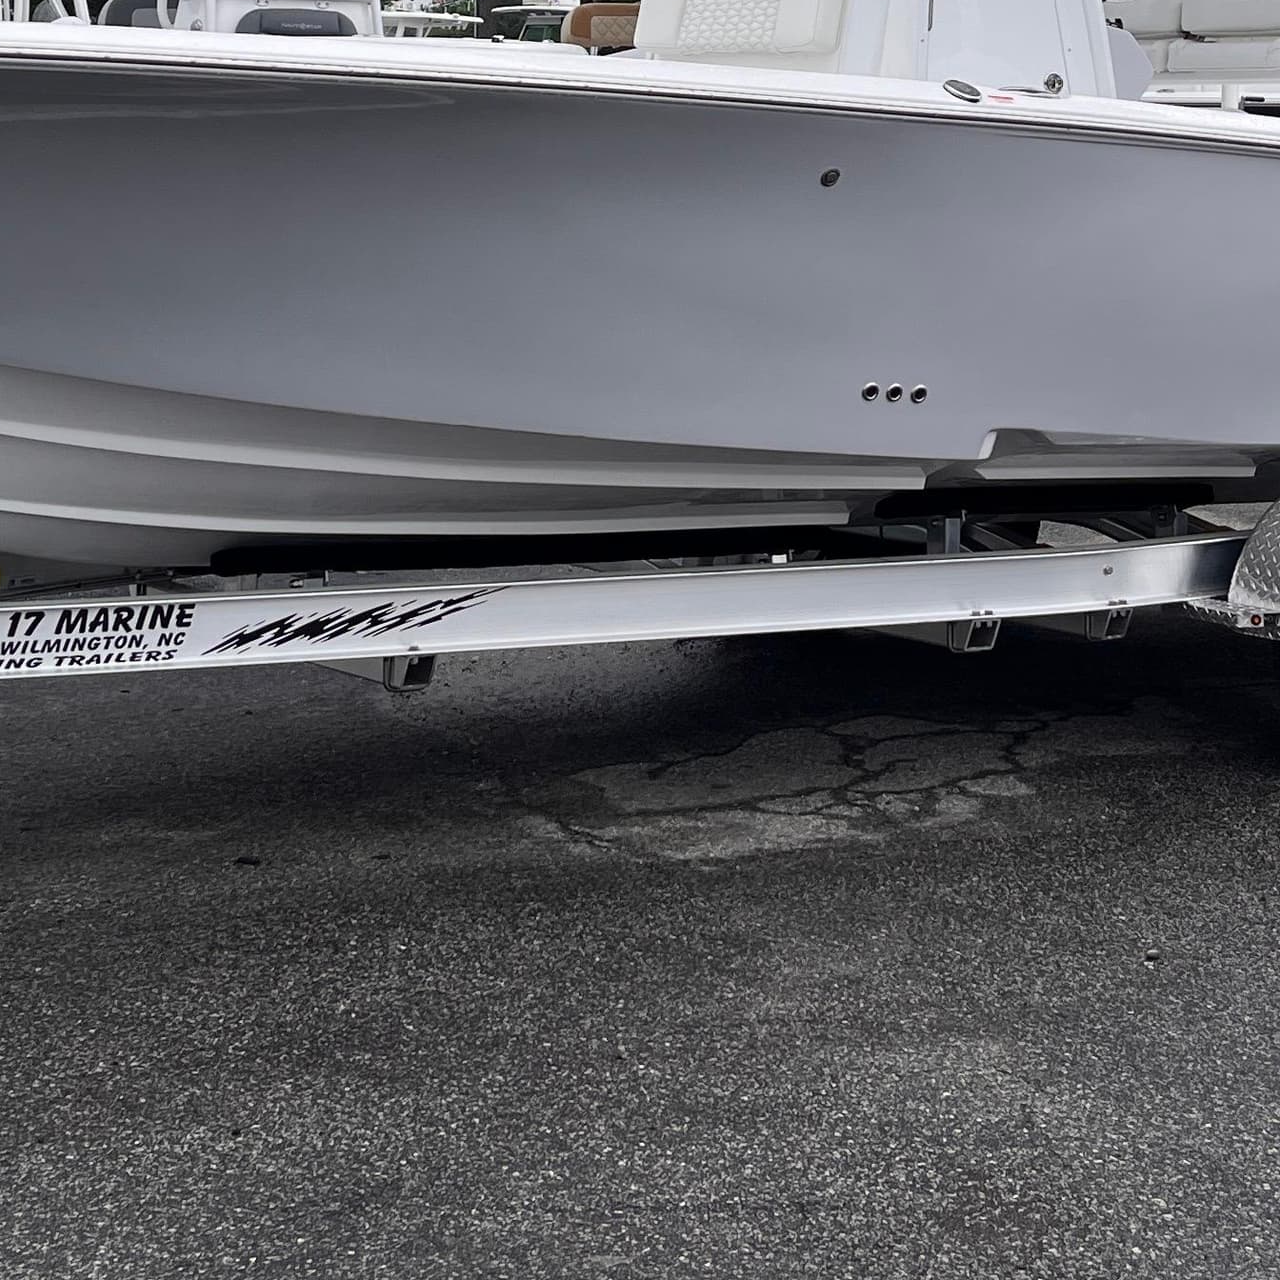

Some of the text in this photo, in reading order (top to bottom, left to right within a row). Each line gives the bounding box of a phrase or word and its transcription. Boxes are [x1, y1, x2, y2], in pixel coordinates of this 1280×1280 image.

[7, 611, 46, 637] 17
[54, 603, 196, 636] MARINE
[0, 634, 150, 657] WILMINGTON,
[158, 631, 187, 647] NC
[54, 649, 179, 668] TRAILERS
